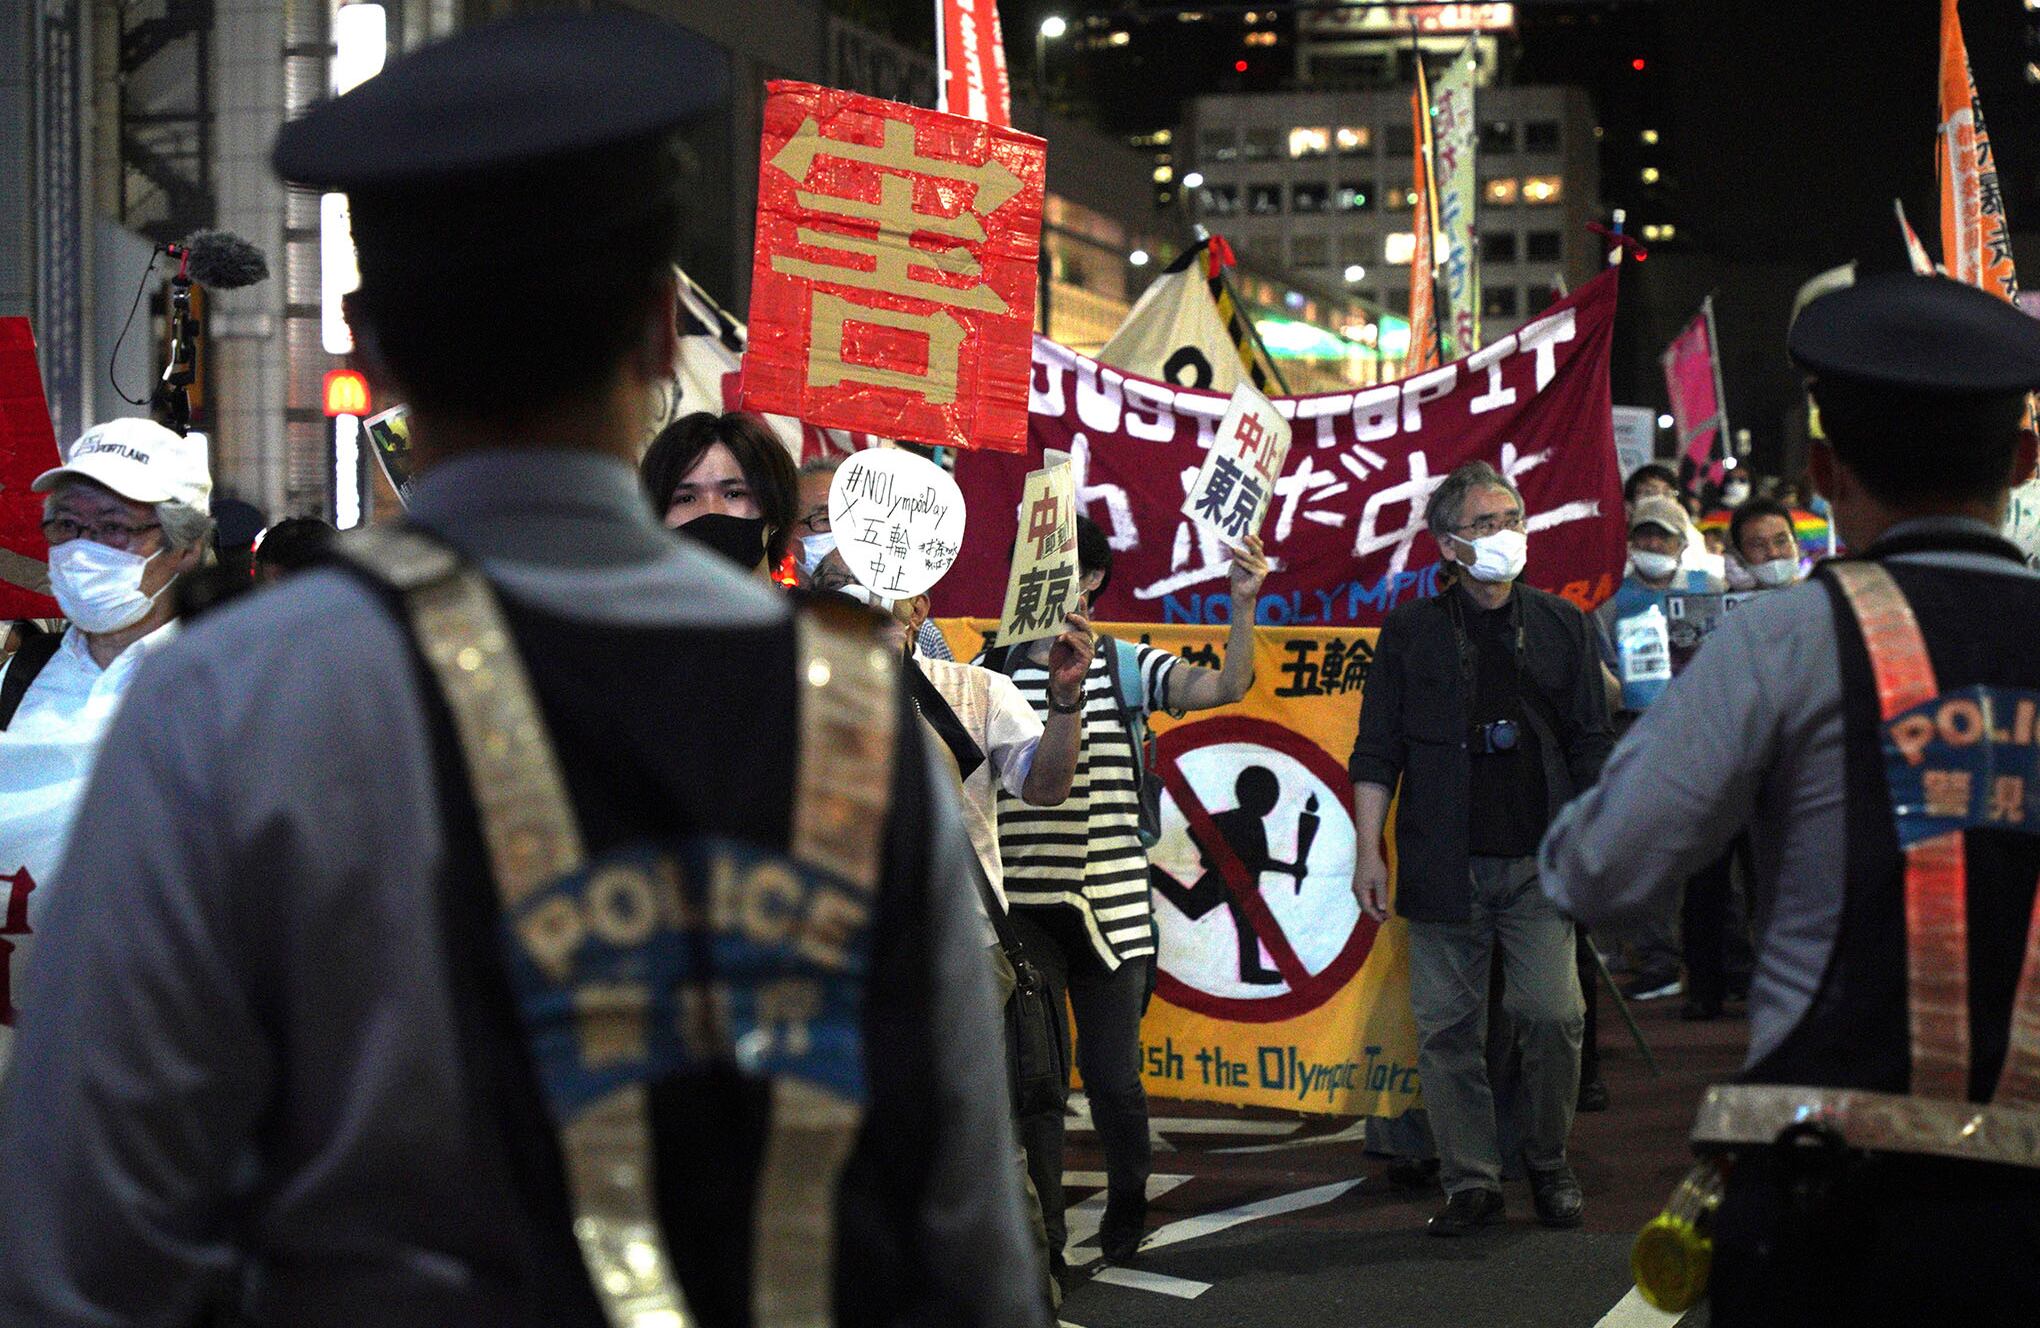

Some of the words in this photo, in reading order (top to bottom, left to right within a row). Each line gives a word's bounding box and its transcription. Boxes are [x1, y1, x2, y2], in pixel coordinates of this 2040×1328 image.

[770, 118, 1025, 404] 害
[1271, 363, 1457, 448] TOP
[1467, 307, 1577, 415] IT
[1234, 411, 1279, 482] 中止
[1194, 455, 1264, 537] 東京
[853, 518, 911, 560] 五輪
[870, 552, 910, 593] 中止
[1009, 561, 1074, 635] 東京
[1163, 593, 1233, 625] NO
[1889, 697, 2040, 768] POLI
[1195, 1046, 1249, 1089] the
[1258, 1045, 1360, 1104] Olympic
